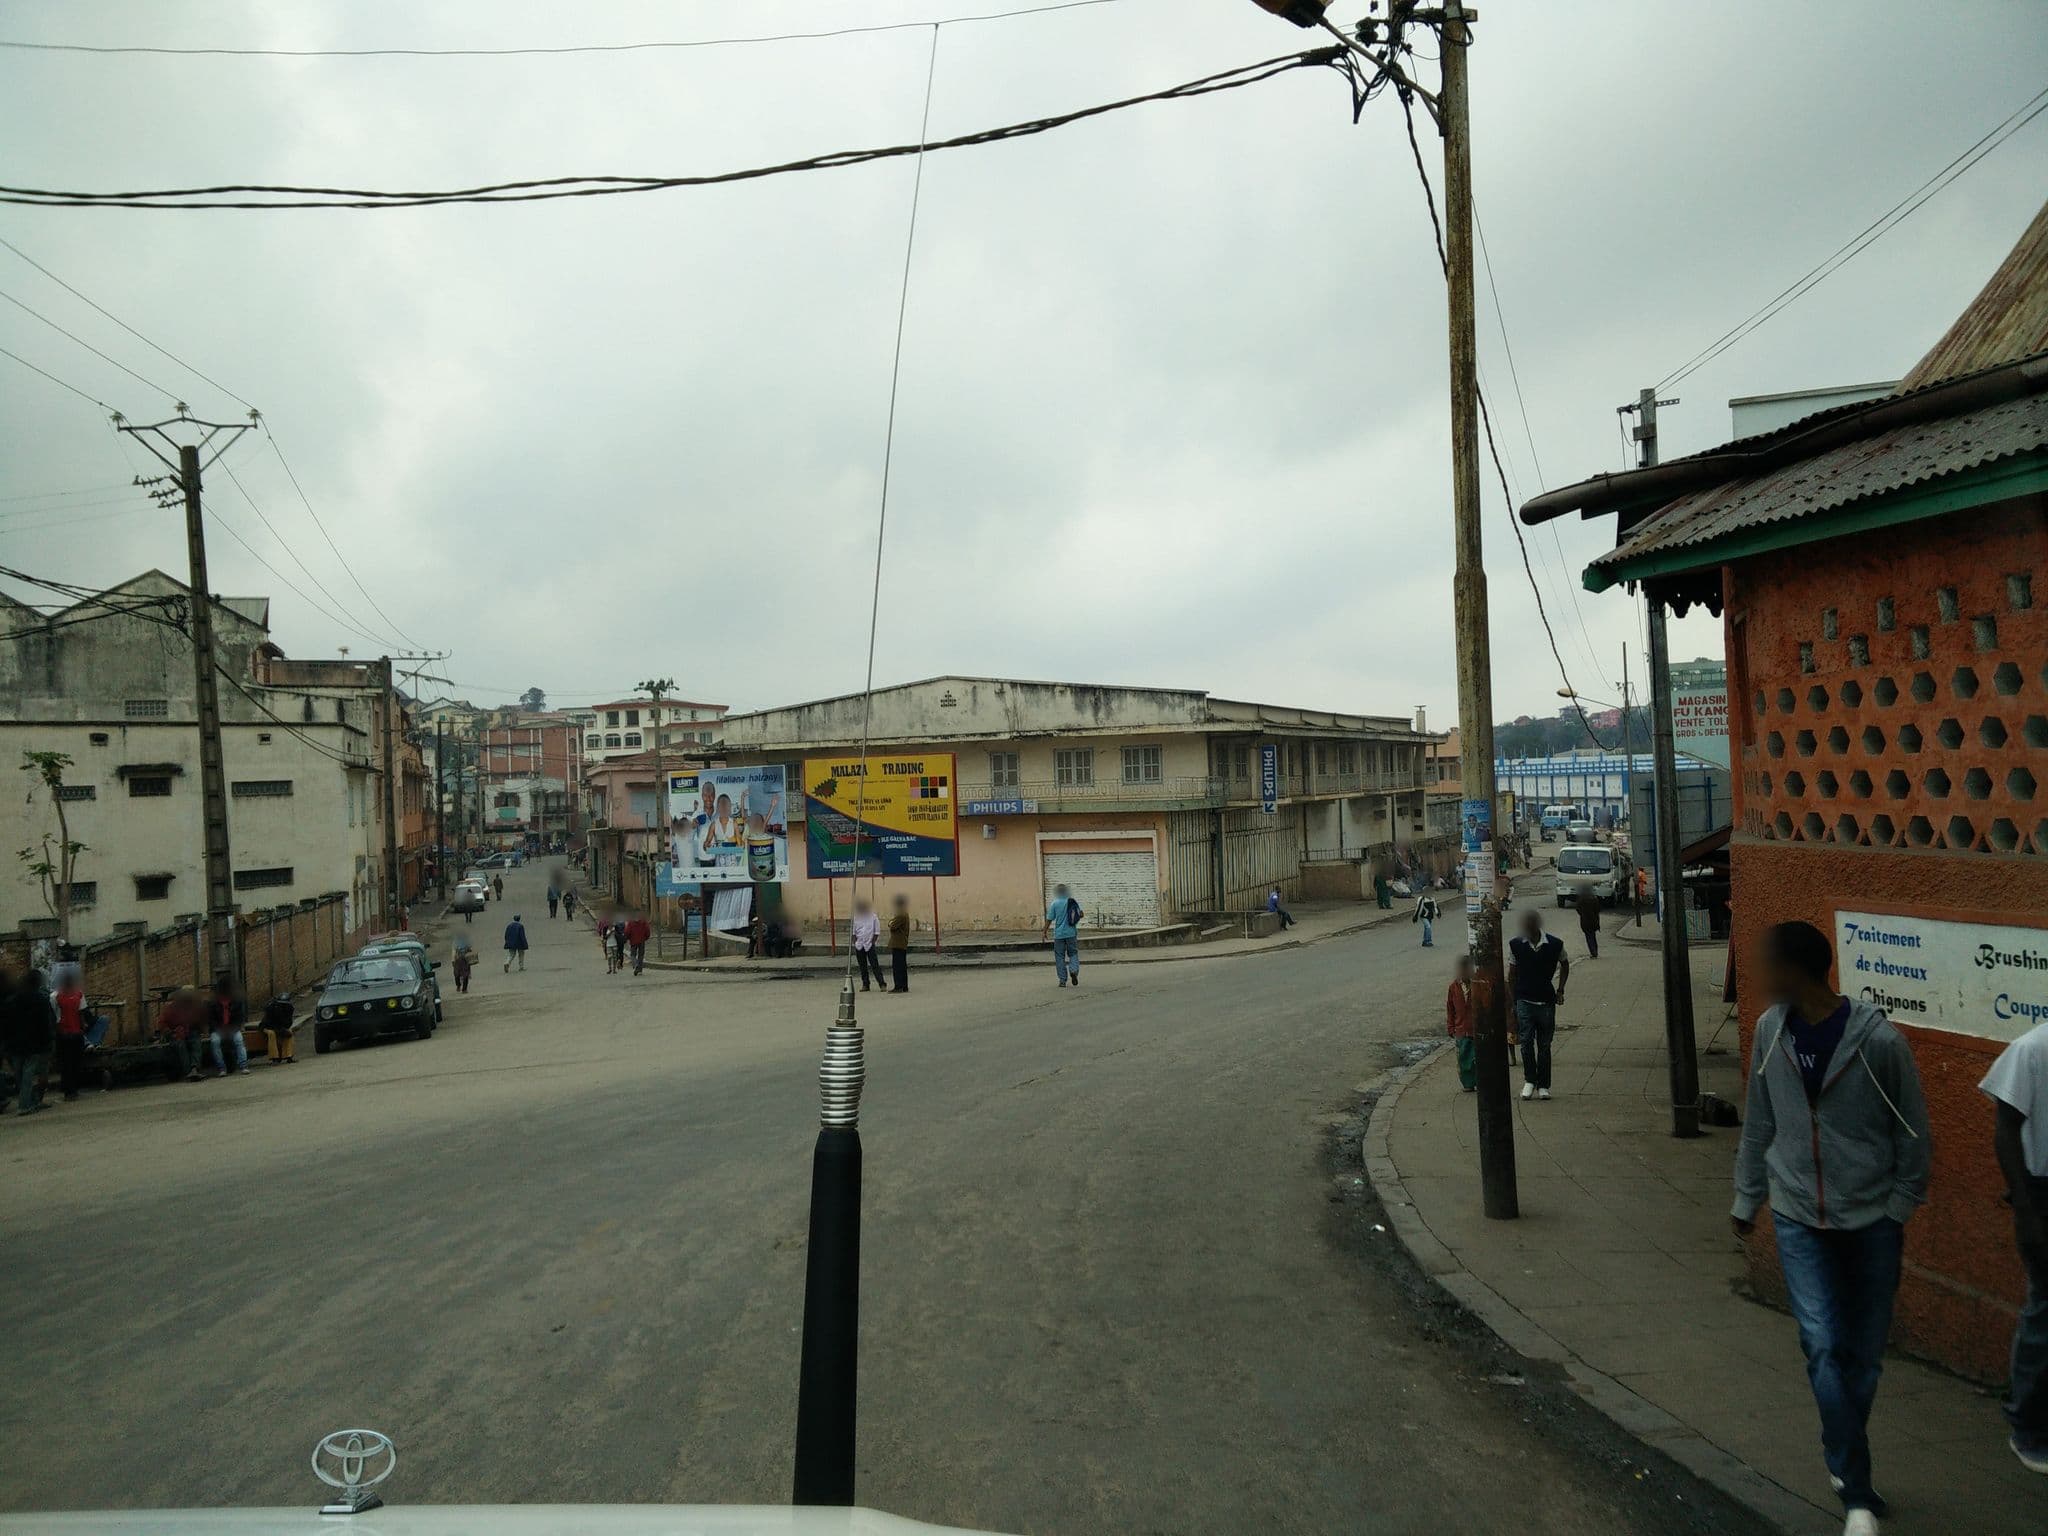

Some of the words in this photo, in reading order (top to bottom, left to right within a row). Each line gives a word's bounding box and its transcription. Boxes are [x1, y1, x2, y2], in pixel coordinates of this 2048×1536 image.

[1678, 695, 1726, 706] MAGASIN
[1673, 707, 1690, 717] FU
[1675, 718, 1705, 727] VENTE
[1676, 729, 1697, 737] GROS
[831, 764, 868, 778] MALAZA
[882, 762, 924, 775] TRADING
[1264, 750, 1274, 796] PHILIPS
[973, 802, 1018, 813] PHILIPS
[1844, 923, 1921, 948] Traitement
[1974, 944, 2048, 970] Brushin
[1856, 954, 1871, 972] de
[1874, 956, 1927, 981] cheveux
[1994, 993, 2048, 1024] Coupe
